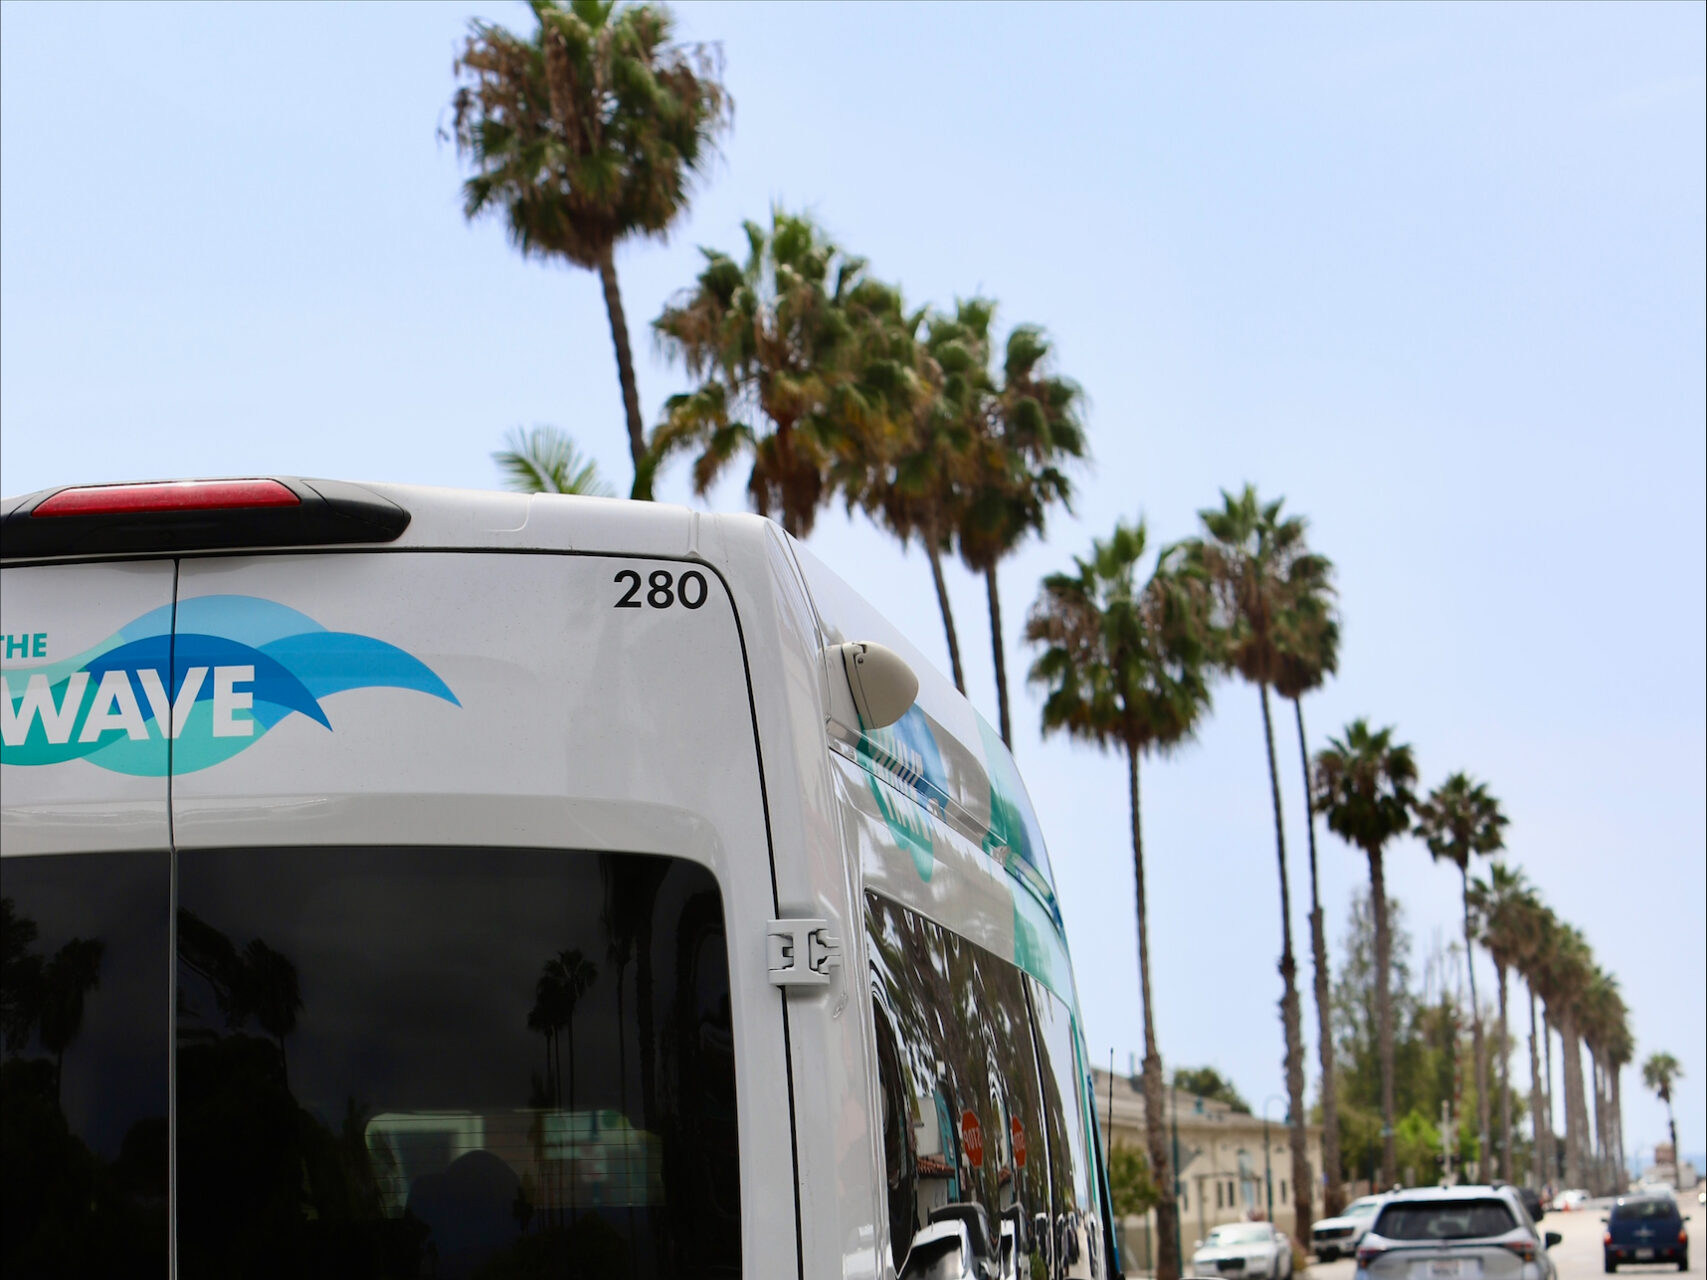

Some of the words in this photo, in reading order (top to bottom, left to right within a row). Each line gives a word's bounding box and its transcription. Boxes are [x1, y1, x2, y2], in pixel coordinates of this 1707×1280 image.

[614, 570, 708, 609] 280
[1, 633, 47, 659] HE
[1, 665, 255, 746] WAVE
